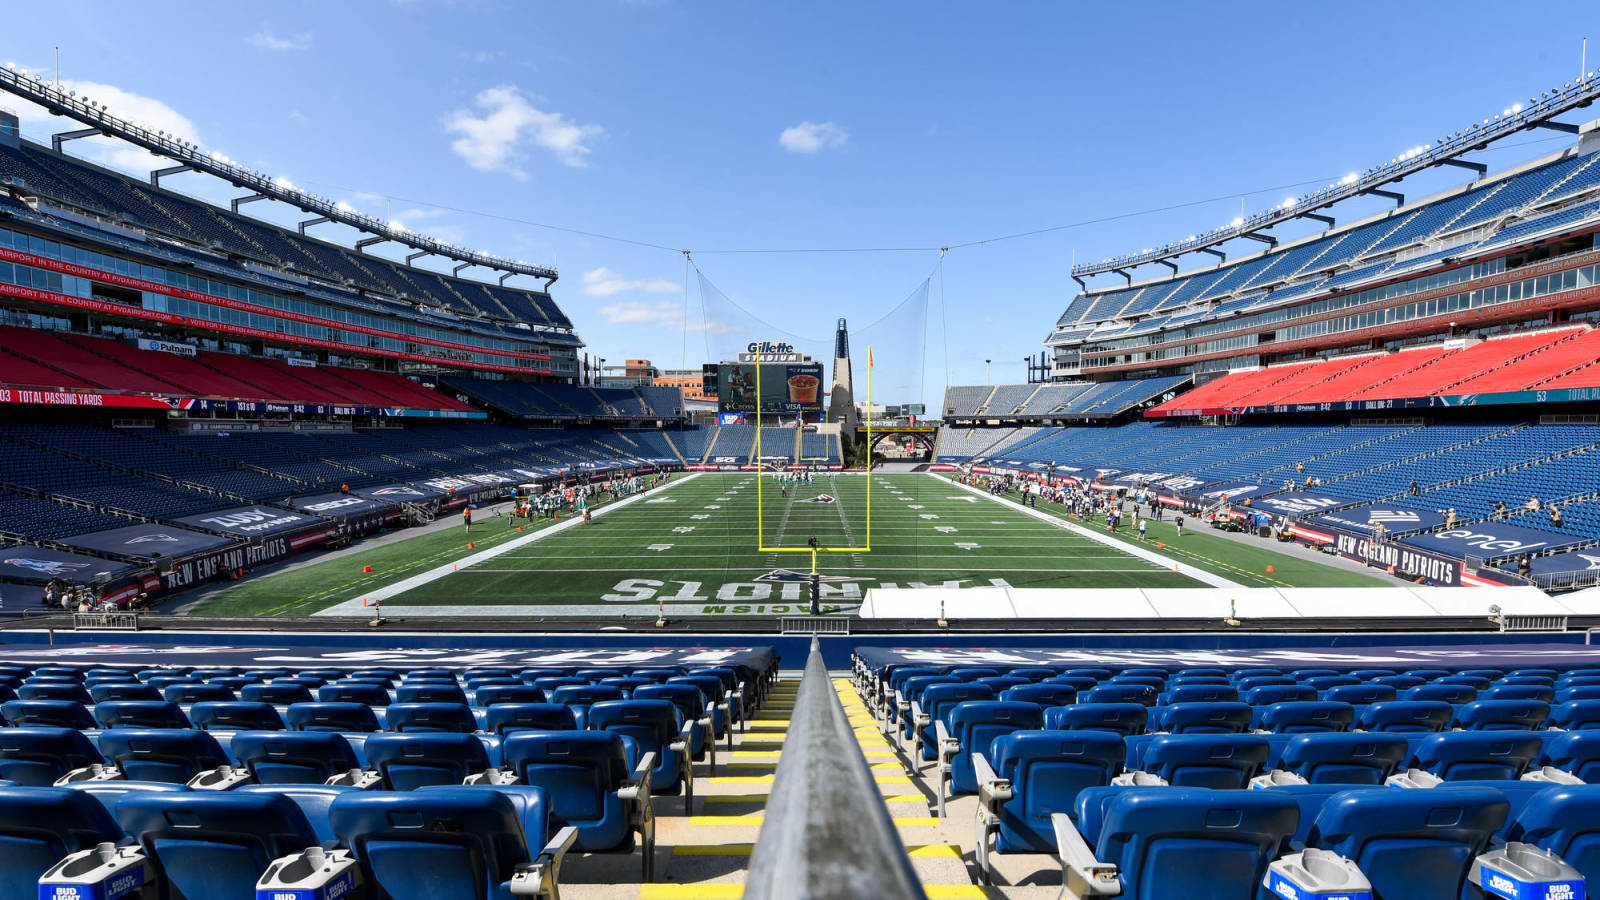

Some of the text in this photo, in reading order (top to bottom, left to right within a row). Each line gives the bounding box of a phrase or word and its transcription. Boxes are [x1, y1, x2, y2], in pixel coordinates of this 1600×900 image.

[0, 249, 36, 264] AIRPORT
[39, 256, 46, 265] IN
[48, 259, 64, 269] THE
[66, 264, 100, 277] COUNTRY
[0, 286, 38, 296] AIRPORT
[50, 294, 65, 302] THE
[67, 297, 101, 308] COUNTRY
[161, 344, 192, 354] Putnam
[748, 342, 793, 353] Gillette
[18, 391, 43, 403] TOTAL
[45, 392, 77, 404] PASSING
[78, 394, 102, 405] YARDS
[1537, 391, 1547, 401] 53
[1568, 388, 1589, 400] TOTAL
[1435, 530, 1548, 552] enel
[168, 538, 286, 588] NEW ENGAND PATRIOTS
[1338, 534, 1452, 584] NEW ENGLAND PATRIOTS
[112, 875, 132, 888] BUD
[329, 881, 344, 893] BUD
[1489, 880, 1518, 896] LIGHT
[1493, 876, 1514, 887] BUD
[108, 881, 136, 896] LIGHT
[1549, 884, 1570, 893] BUD
[1545, 892, 1575, 900] LIGHT
